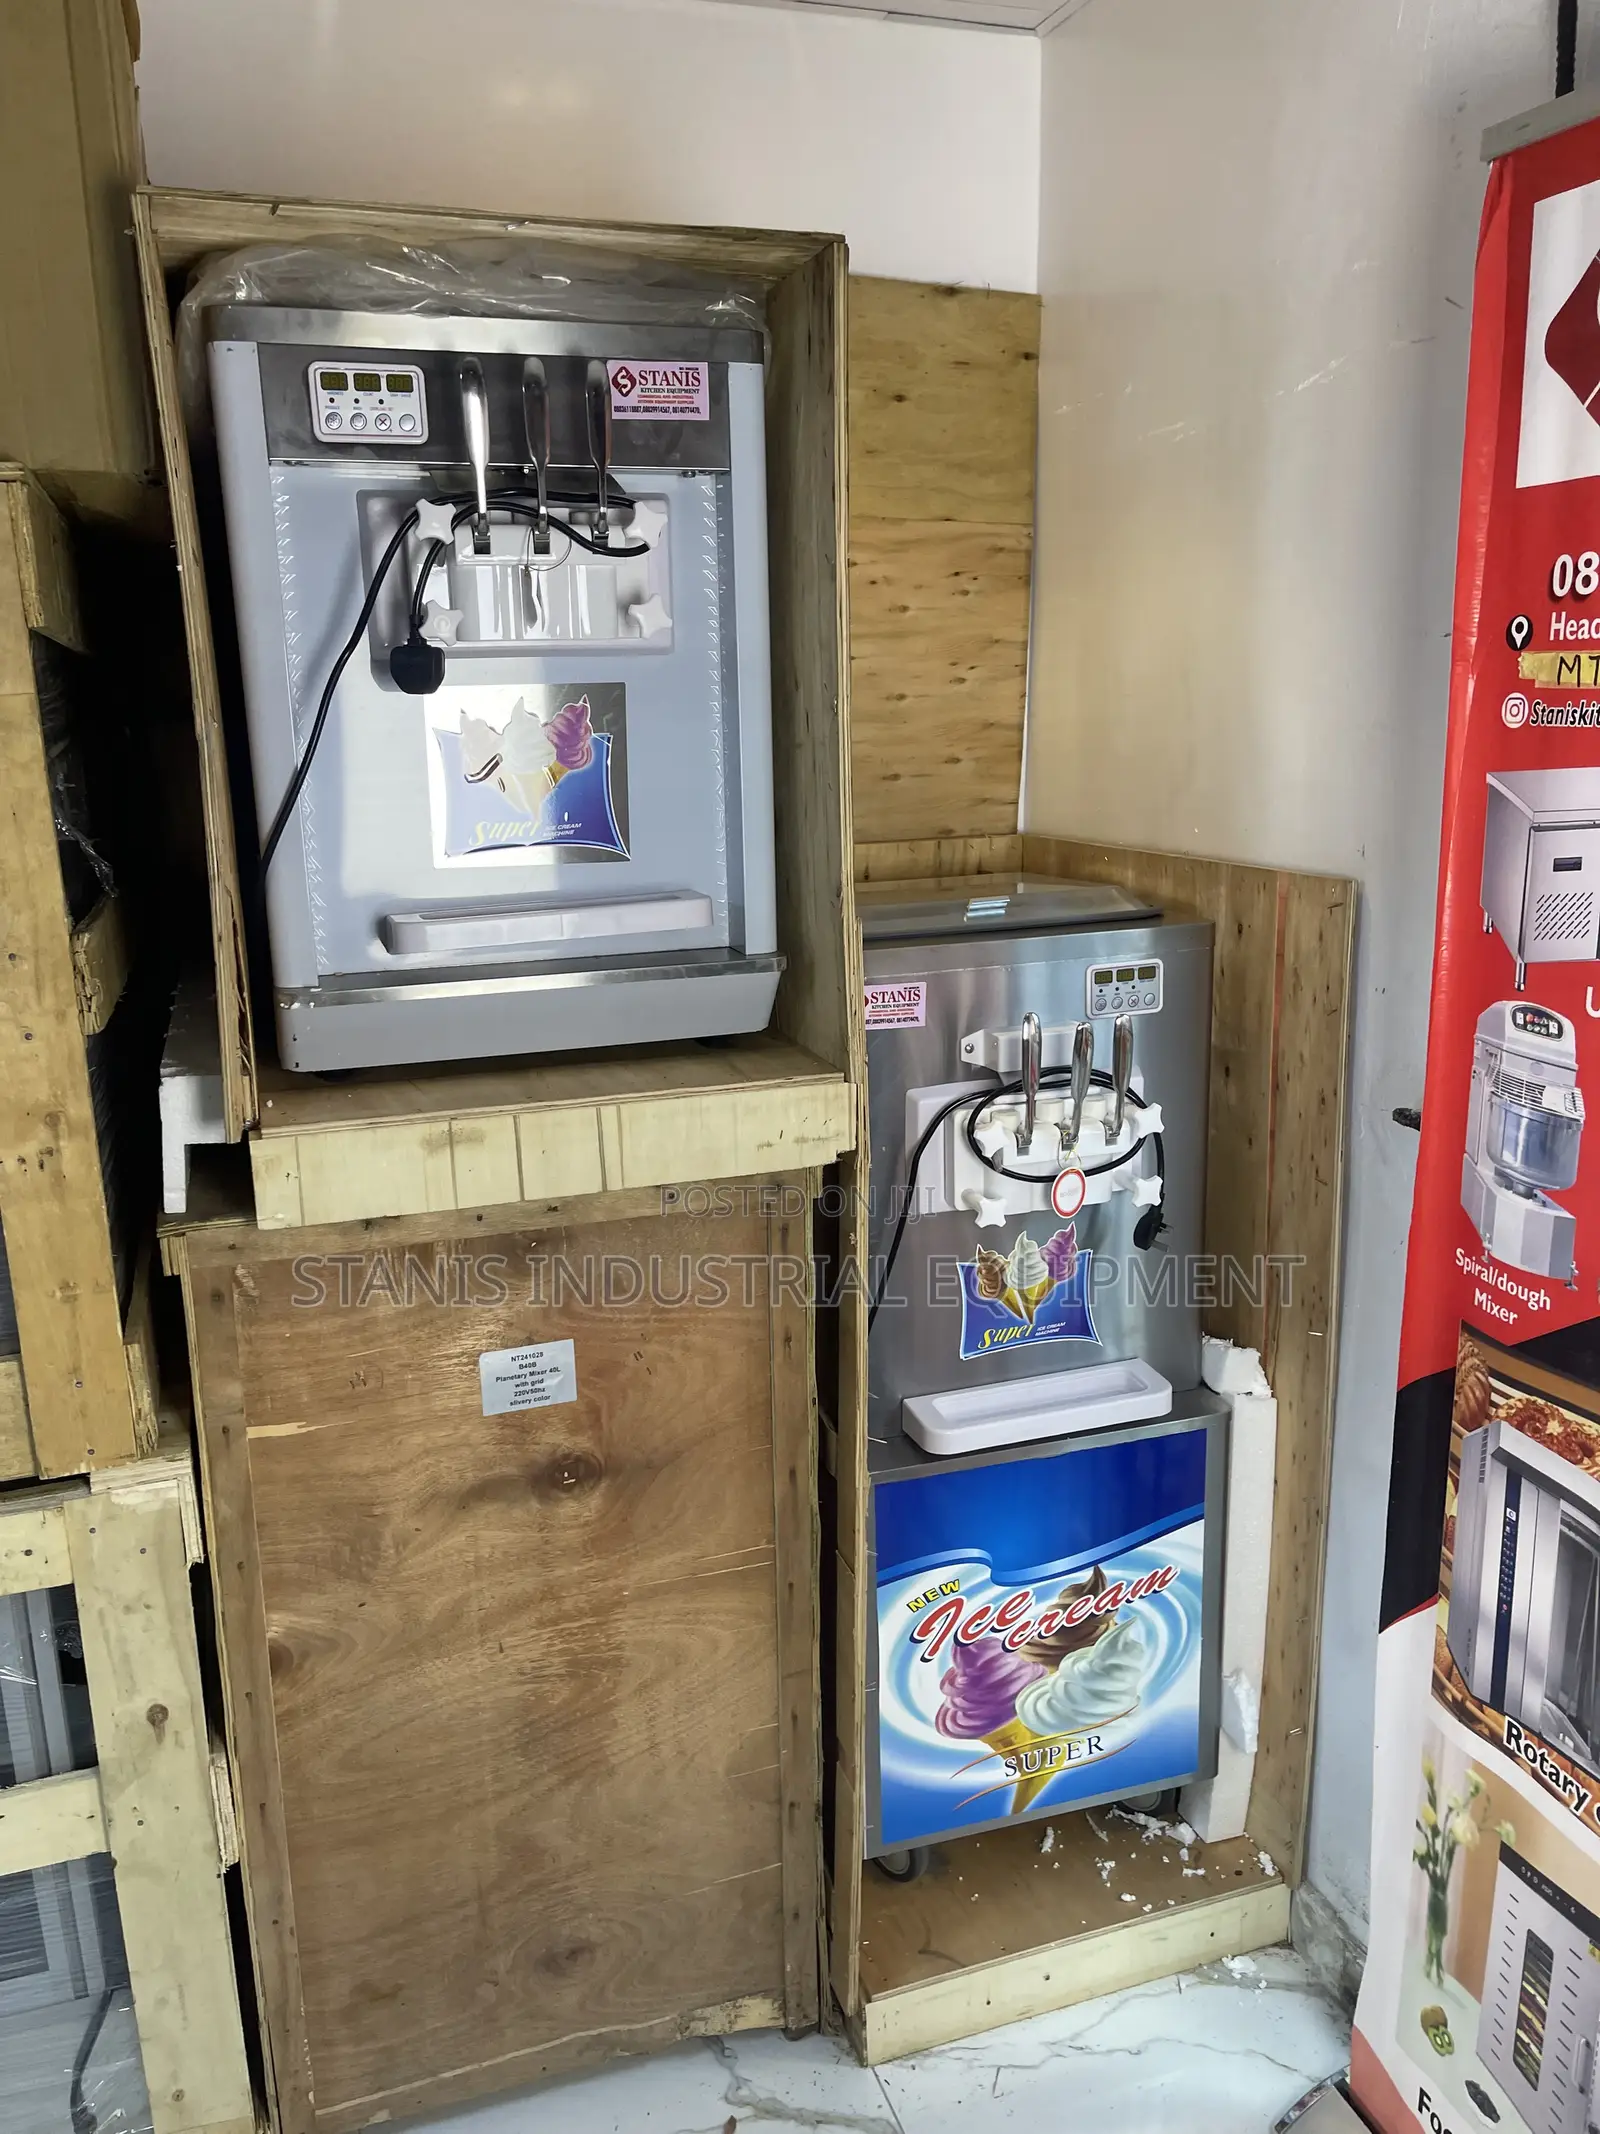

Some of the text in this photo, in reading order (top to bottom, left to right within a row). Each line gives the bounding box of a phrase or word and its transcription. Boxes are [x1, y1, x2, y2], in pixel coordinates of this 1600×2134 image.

[638, 370, 701, 387] STANIS
[469, 819, 543, 846] Super
[557, 822, 582, 830] CREAM
[870, 990, 921, 1004] STANIS
[1455, 1247, 1551, 1311] Spiral/dough
[1473, 1287, 1518, 1325] Mixer
[977, 1323, 1036, 1348] Super
[1035, 1328, 1060, 1336] MACHINE
[495, 1366, 561, 1382] Planetary Mixer 40L
[514, 1378, 545, 1388] with grid
[906, 1579, 960, 1613] NEW
[910, 1564, 1180, 1663] Ice cream
[1004, 1735, 1105, 1778] SUPER
[1504, 1717, 1590, 1813] Rotary
[1417, 2086, 1452, 2134] Fo
